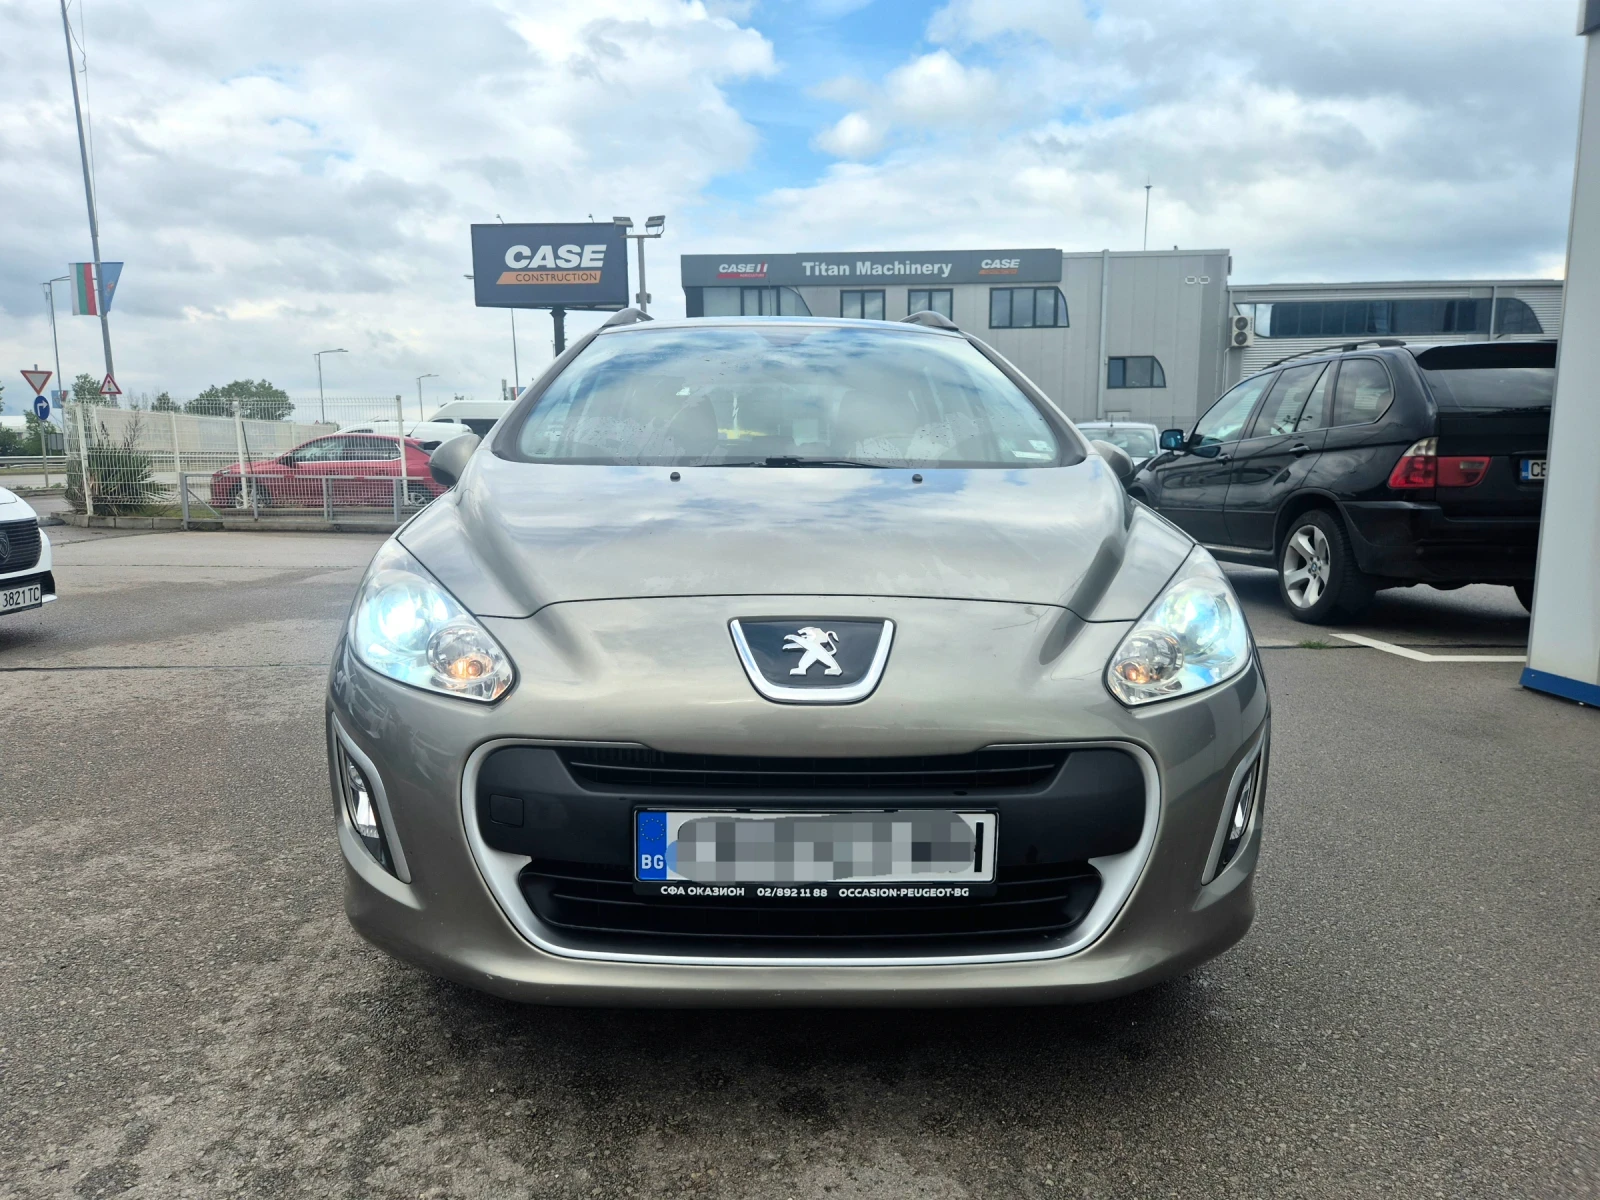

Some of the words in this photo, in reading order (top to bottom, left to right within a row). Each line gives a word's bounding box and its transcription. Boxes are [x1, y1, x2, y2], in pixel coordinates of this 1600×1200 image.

[504, 244, 607, 269] CASE
[718, 263, 756, 273] CASE
[802, 261, 850, 276] Titan
[856, 260, 953, 278] Machinery
[981, 258, 1020, 269] CASE
[515, 272, 597, 282] CONSTRUCTION
[3, 590, 26, 608] 3821
[28, 587, 40, 603] TC
[641, 854, 664, 869] BG
[660, 885, 686, 895] СФА
[687, 886, 745, 896] ОКАЗИОН
[756, 887, 798, 897] 02/892
[799, 888, 811, 897] 11
[812, 888, 828, 897] 88
